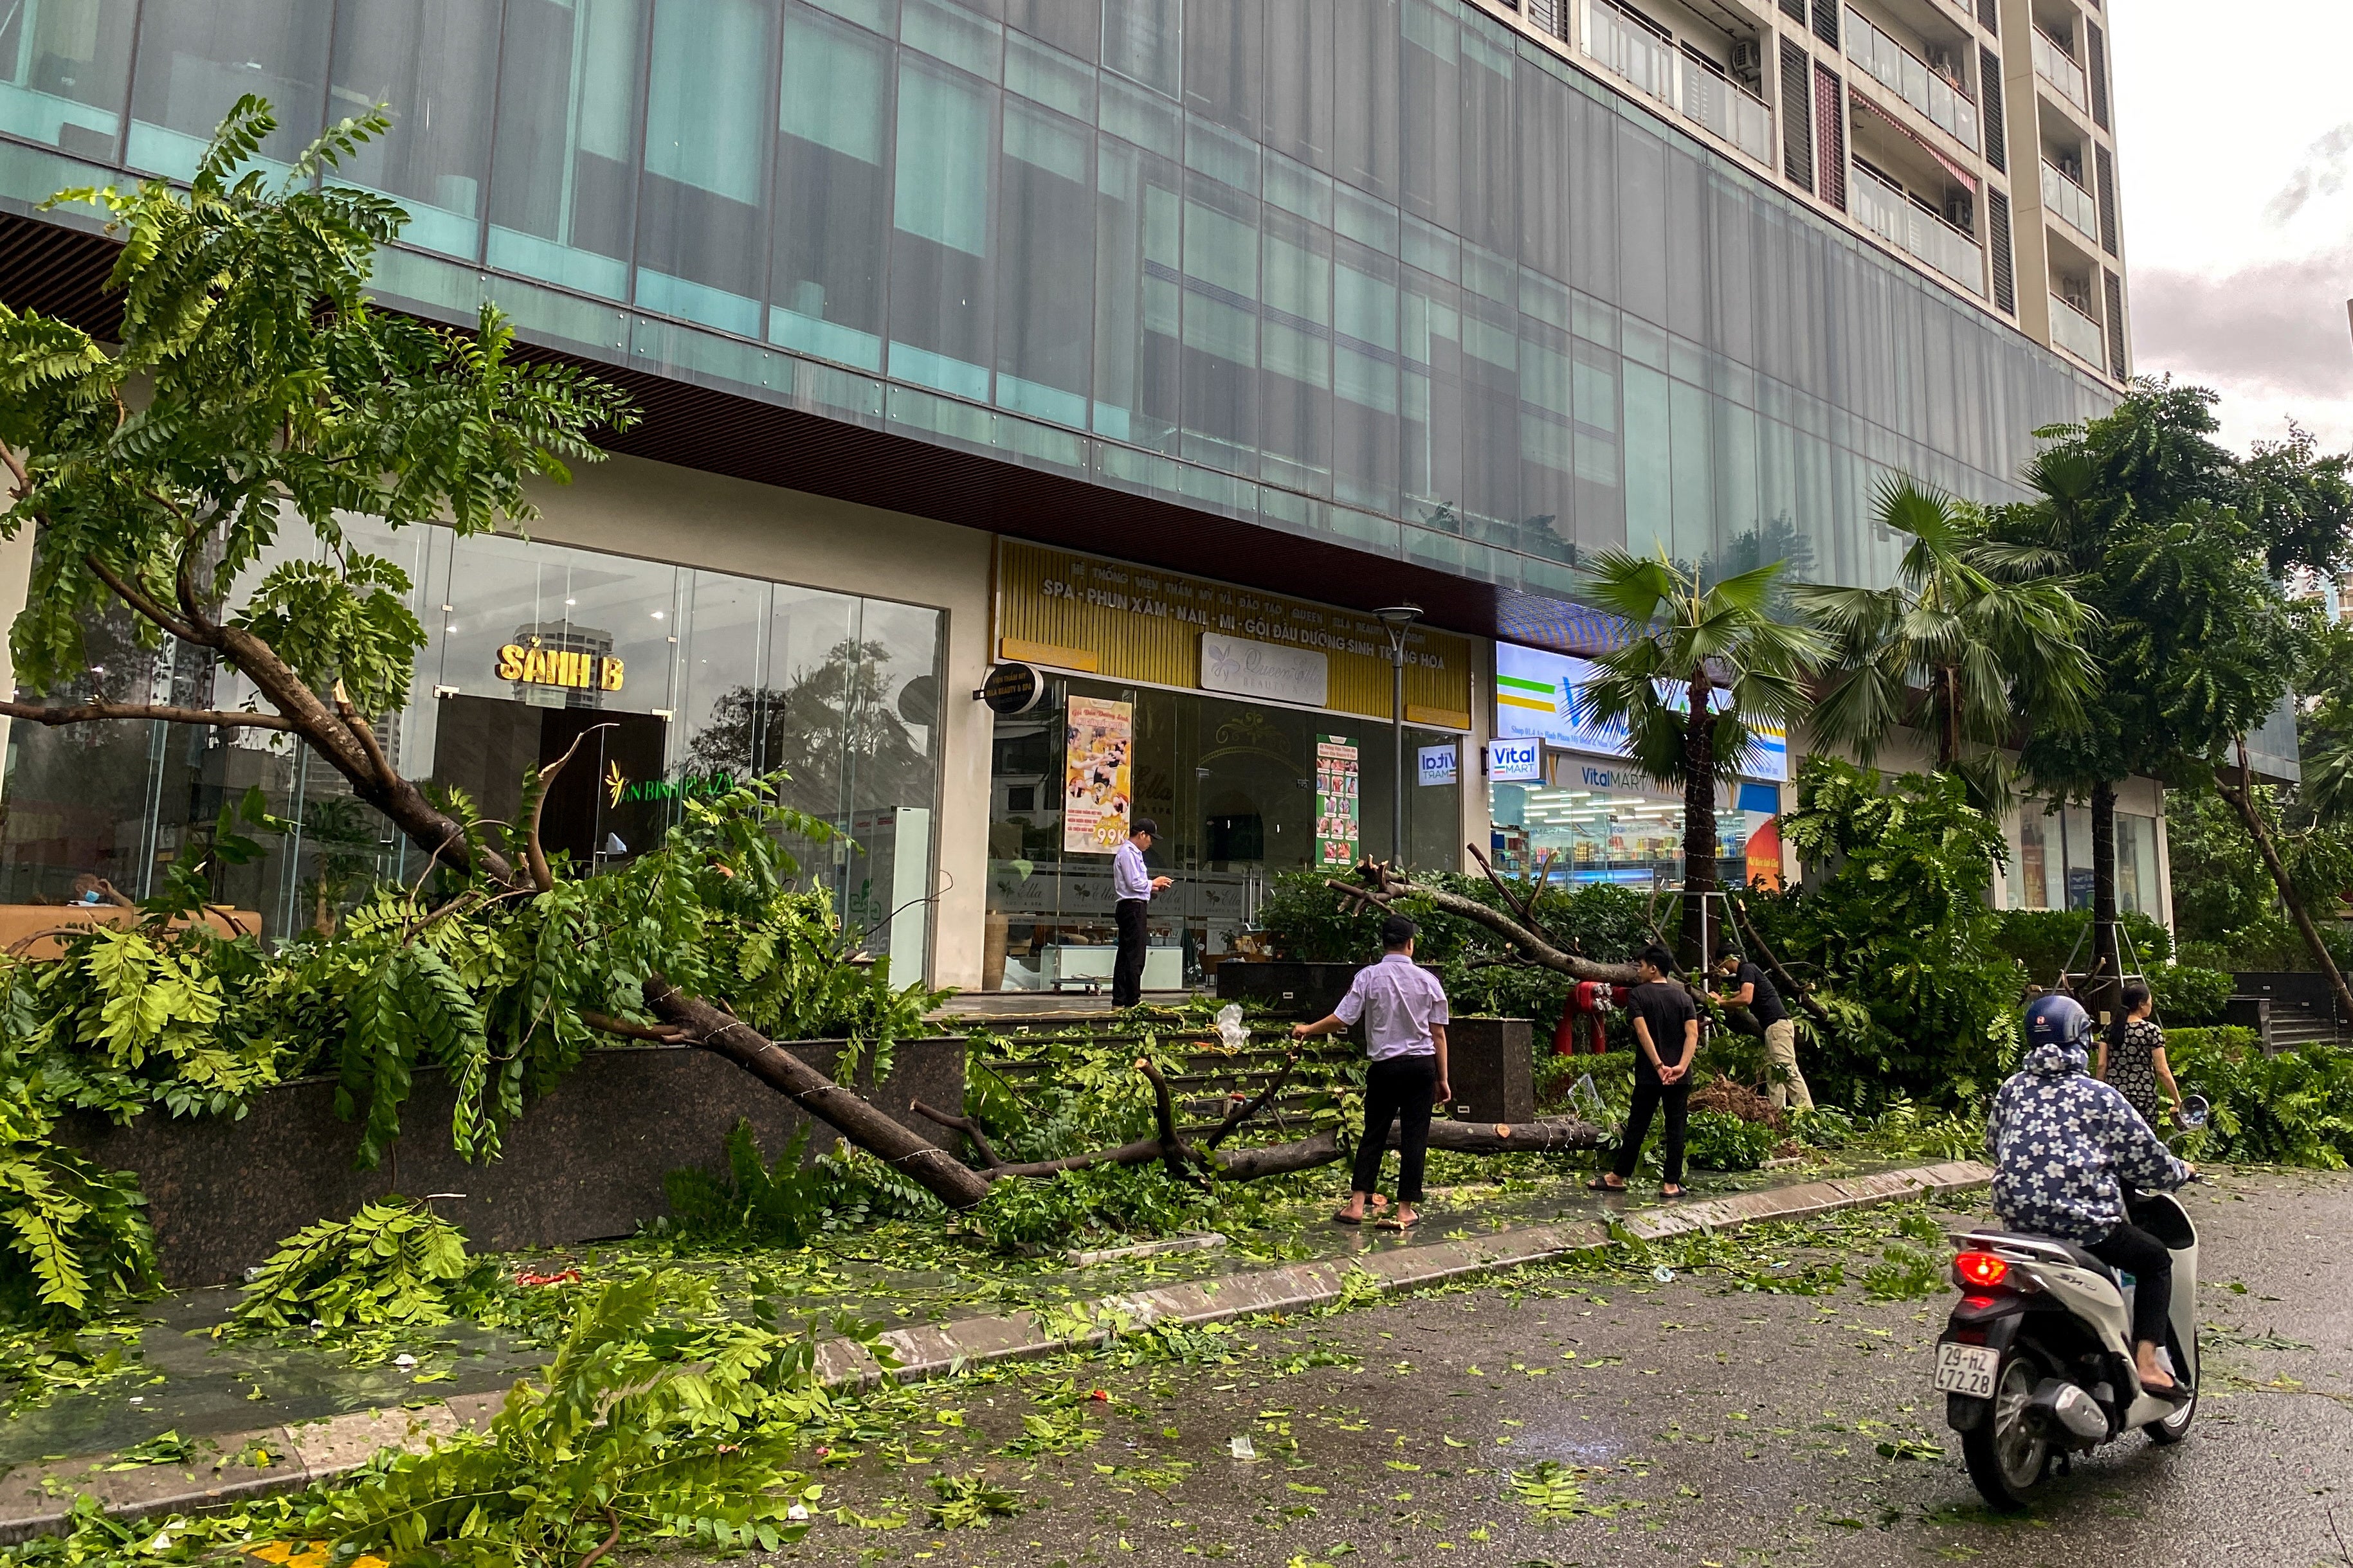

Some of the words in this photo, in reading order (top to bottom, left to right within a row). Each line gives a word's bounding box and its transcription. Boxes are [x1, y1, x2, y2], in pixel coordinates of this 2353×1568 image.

[1093, 564, 1129, 584] THỐNG
[1291, 608, 1323, 625] QUEEN
[1391, 628, 1426, 644] CDEMY
[1043, 578, 1075, 600] SPA
[1087, 588, 1129, 609] PHUN
[1131, 595, 1167, 618] XĂM
[1176, 605, 1210, 626] NAIL
[1219, 613, 1235, 630] MI
[1244, 615, 1269, 640] GỘI
[1273, 618, 1298, 642] ĐẦU
[1300, 627, 1345, 651] DƯỠNG
[1347, 638, 1374, 657] SINH
[1378, 644, 1417, 664] TRNG
[1421, 653, 1445, 670] HOA
[496, 635, 592, 689] SẢNH
[597, 656, 625, 691] B
[1244, 647, 1291, 680] Queen
[1022, 682, 1033, 692] SPA
[1243, 678, 1286, 692] BEAUTY
[1304, 688, 1323, 699] SPA
[1511, 725, 1524, 736] Shop
[1494, 746, 1535, 764] Vital
[1505, 763, 1535, 773] MART
[1581, 766, 1648, 792] VitalMART
[621, 781, 641, 803] AN
[1097, 827, 1128, 845] 99K
[1943, 1346, 1988, 1372] 29-H2
[1937, 1367, 1990, 1394] 472.28
